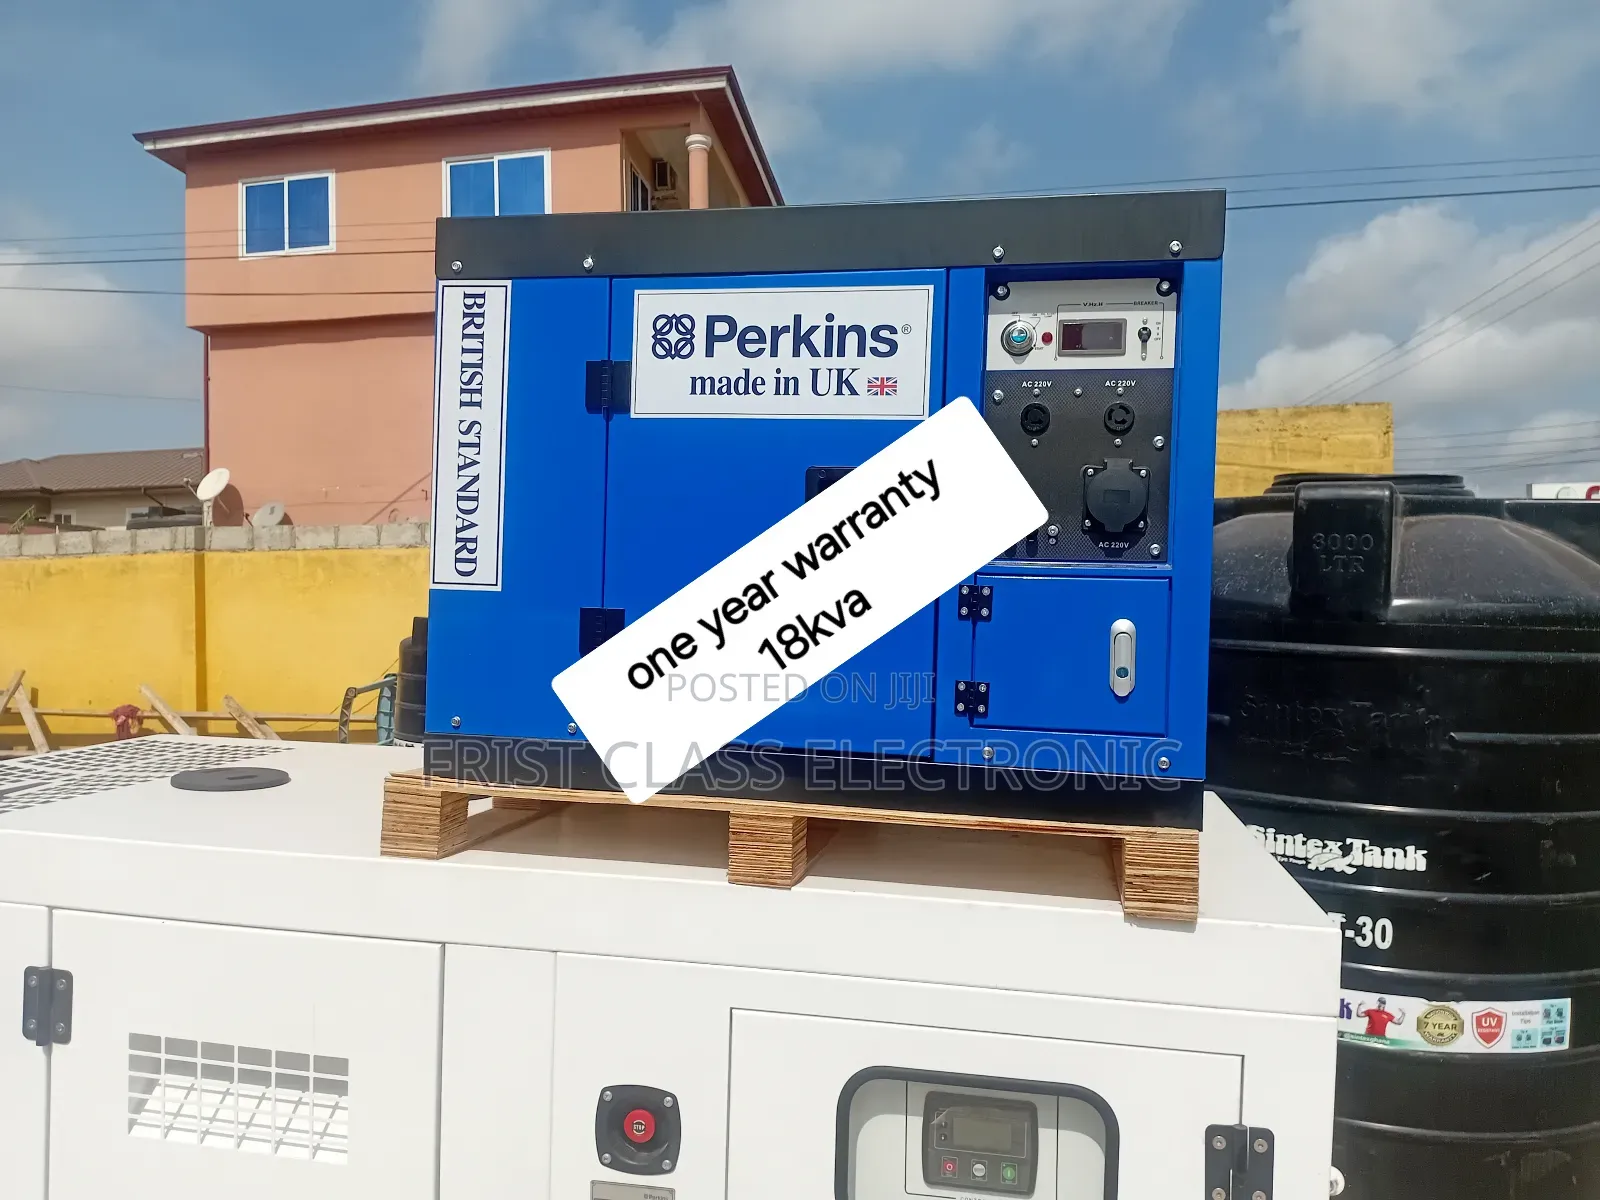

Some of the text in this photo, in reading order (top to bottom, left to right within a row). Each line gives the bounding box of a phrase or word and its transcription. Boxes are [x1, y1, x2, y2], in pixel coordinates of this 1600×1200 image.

[689, 368, 861, 397] made in UK
[453, 290, 487, 578] BRITISH STANDARD
[1312, 532, 1375, 551] 3000
[1319, 554, 1366, 574] LTR
[1346, 838, 1428, 872] Tank
[1423, 1021, 1457, 1030] 7 YEAR
[1481, 1017, 1498, 1027] UV
